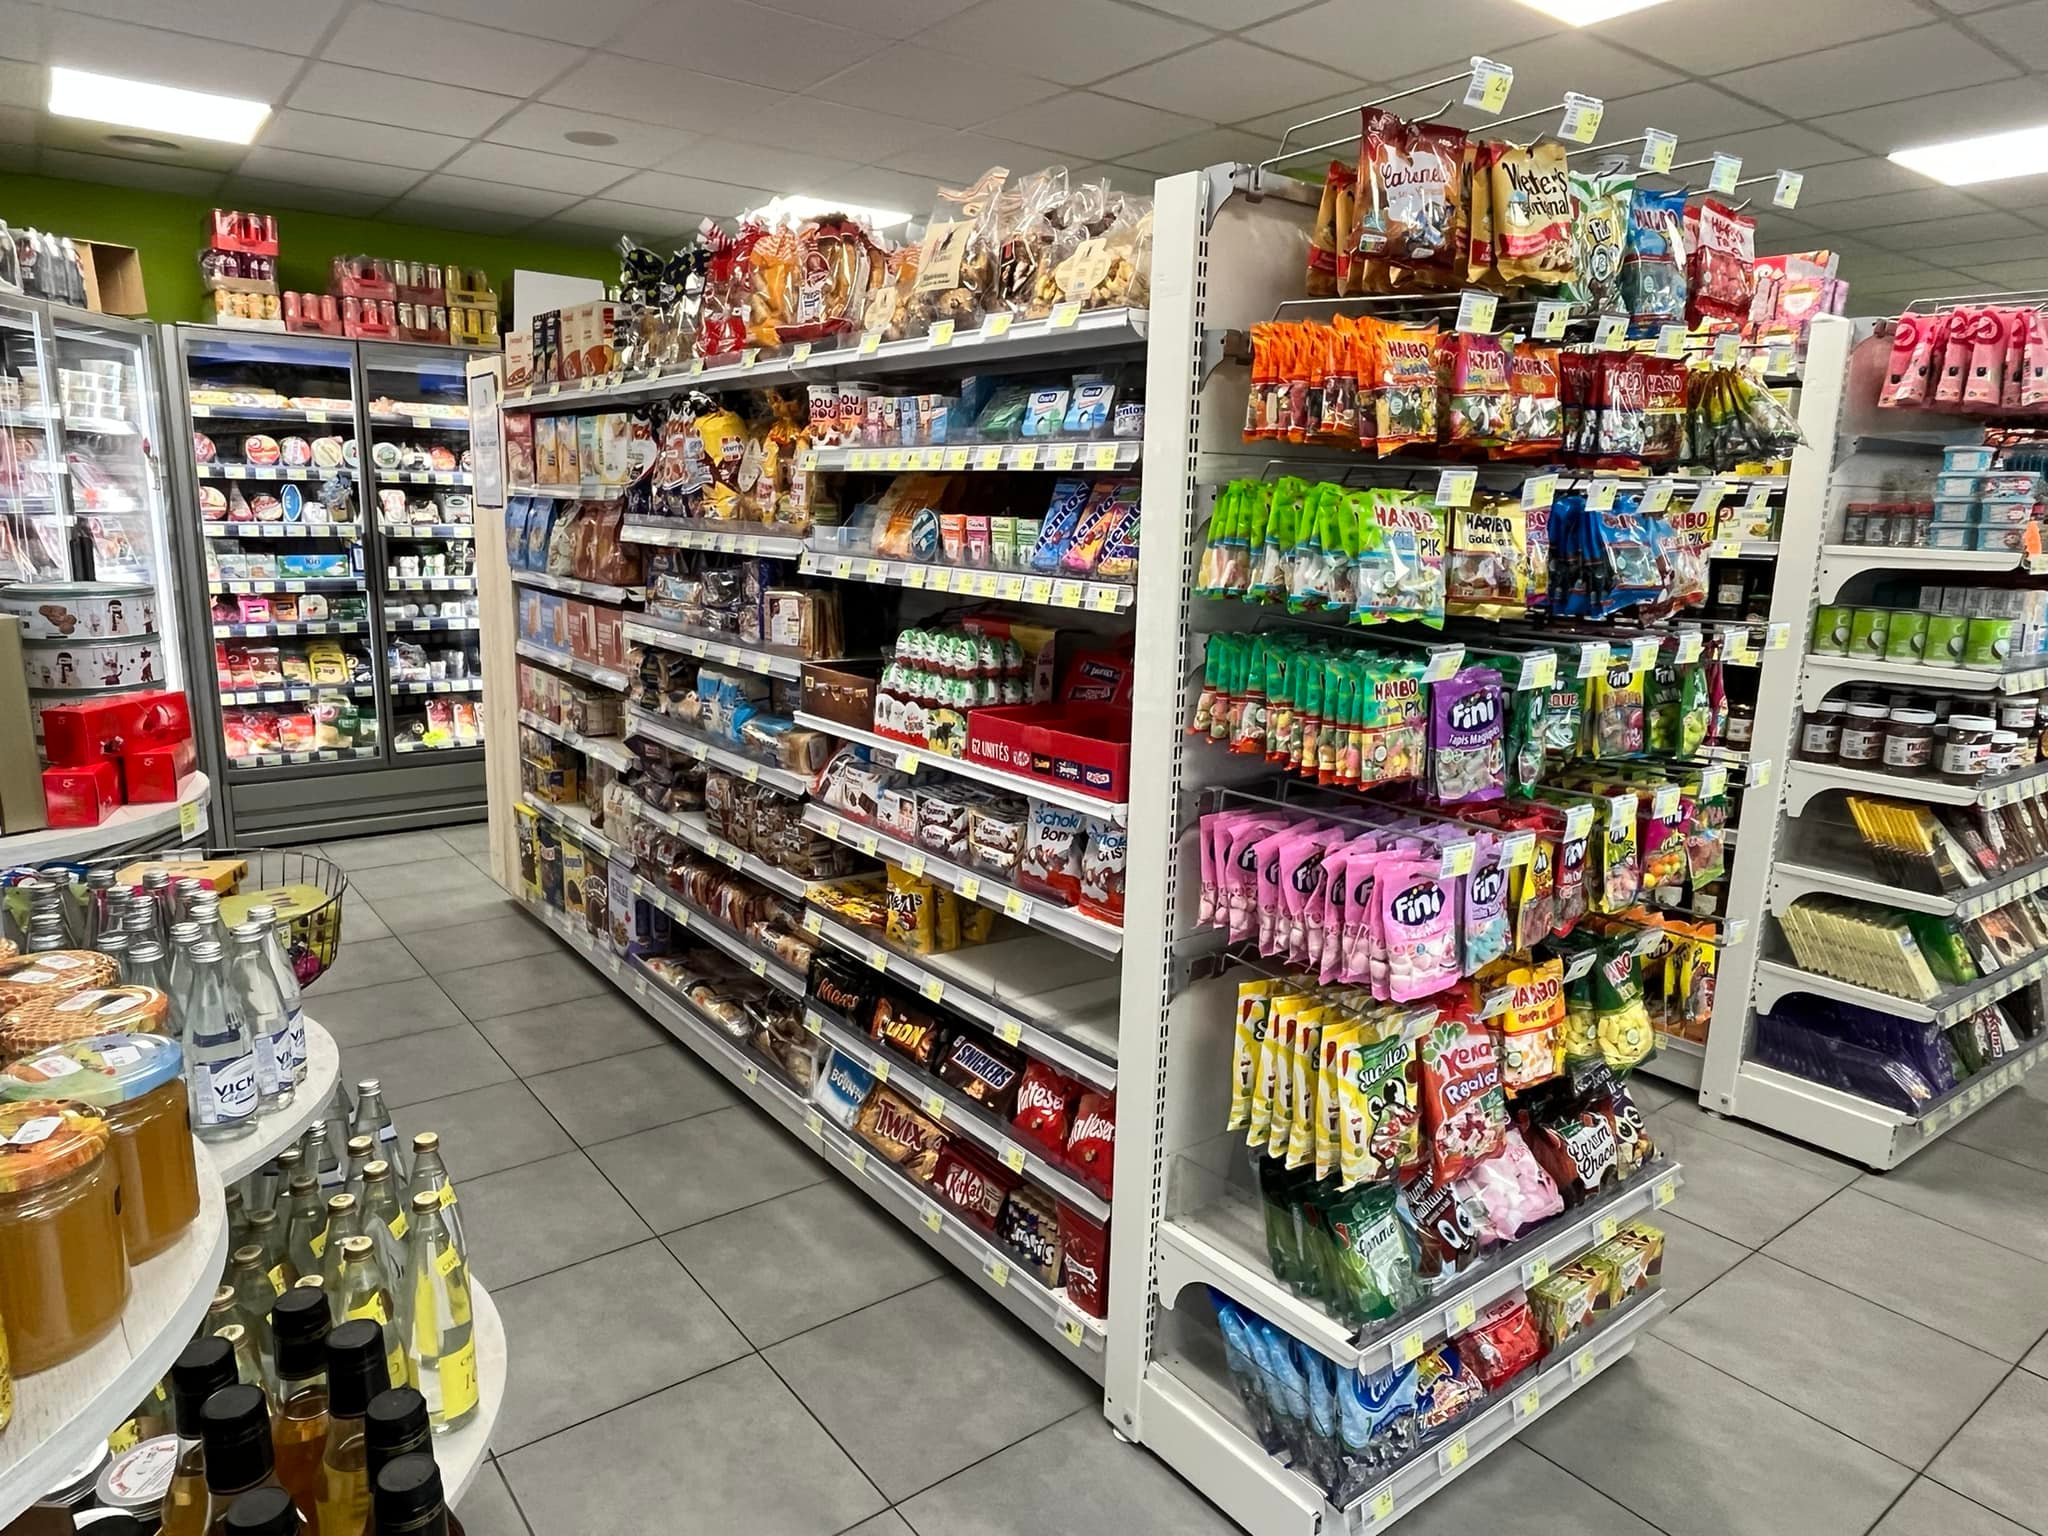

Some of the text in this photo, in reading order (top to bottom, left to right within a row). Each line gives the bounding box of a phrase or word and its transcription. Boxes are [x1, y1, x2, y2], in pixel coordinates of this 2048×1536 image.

[1452, 692, 1495, 729] Fini
[971, 738, 981, 755] 62
[981, 742, 1010, 762] UNITÉS
[1394, 885, 1441, 923] Fini
[886, 1021, 927, 1049] LION
[955, 1044, 1012, 1088] SNICKERS
[214, 1072, 256, 1098] VICH
